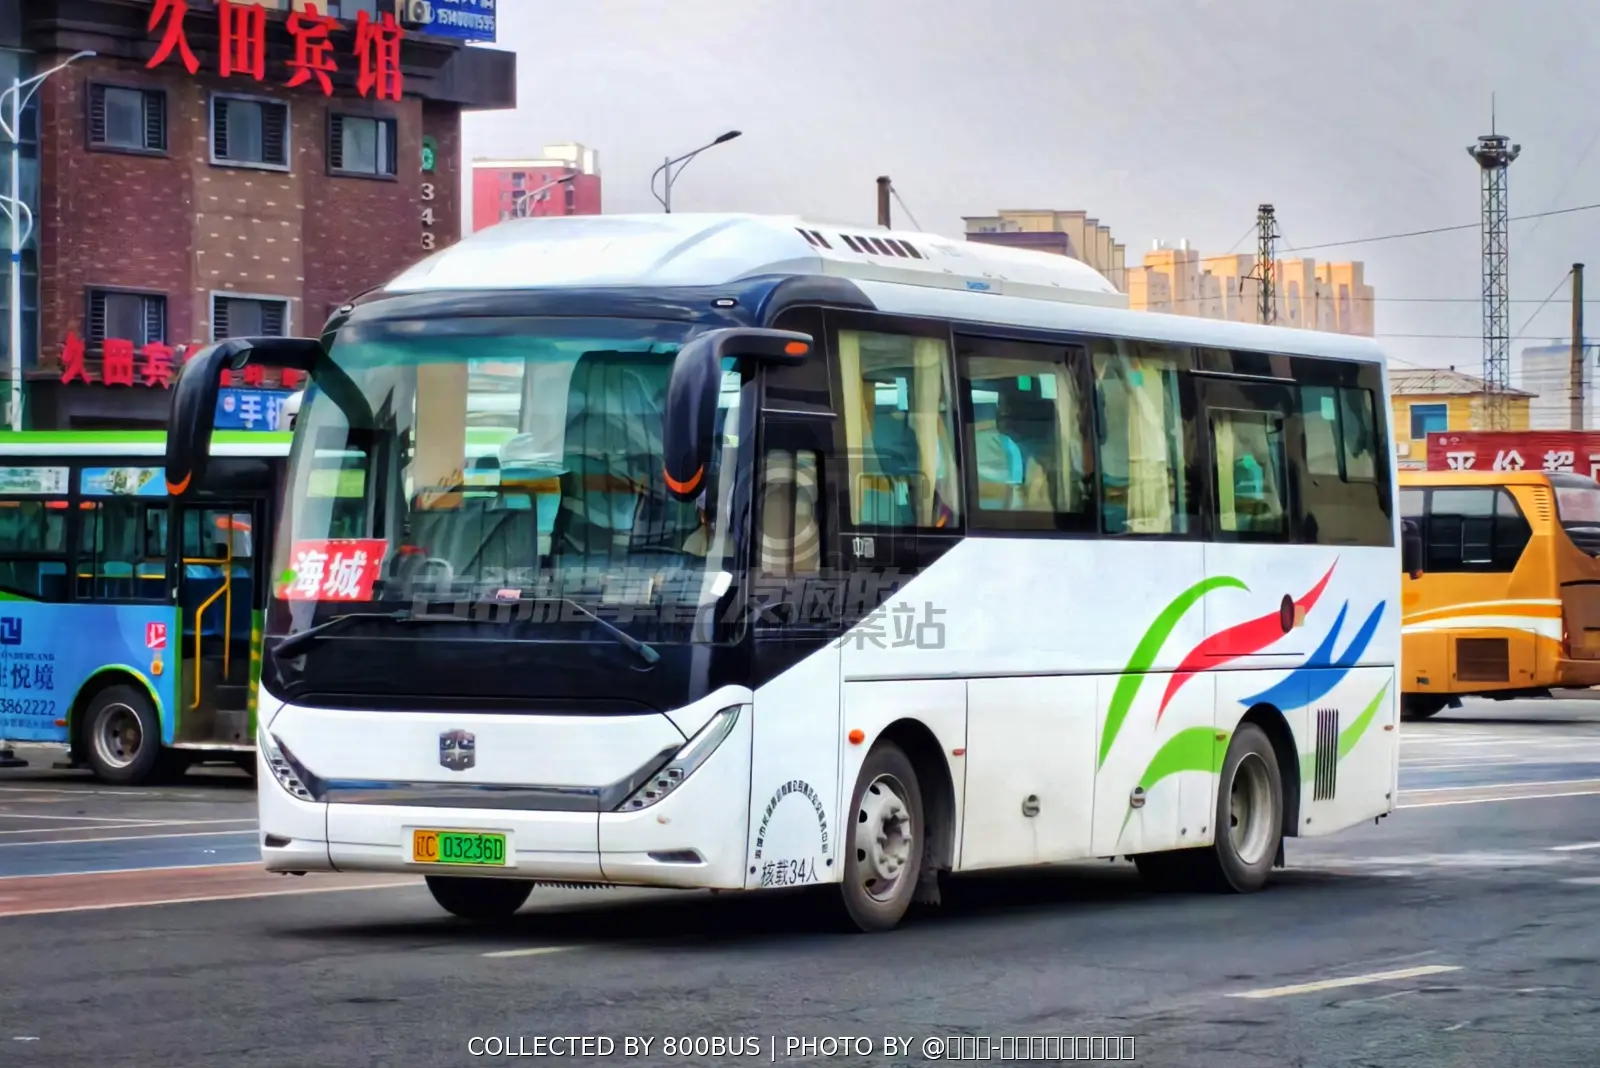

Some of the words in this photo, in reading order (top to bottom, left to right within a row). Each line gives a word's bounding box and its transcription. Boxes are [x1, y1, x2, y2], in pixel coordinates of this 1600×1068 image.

[60, 331, 206, 390] 久田宾
[285, 550, 367, 599] 海城
